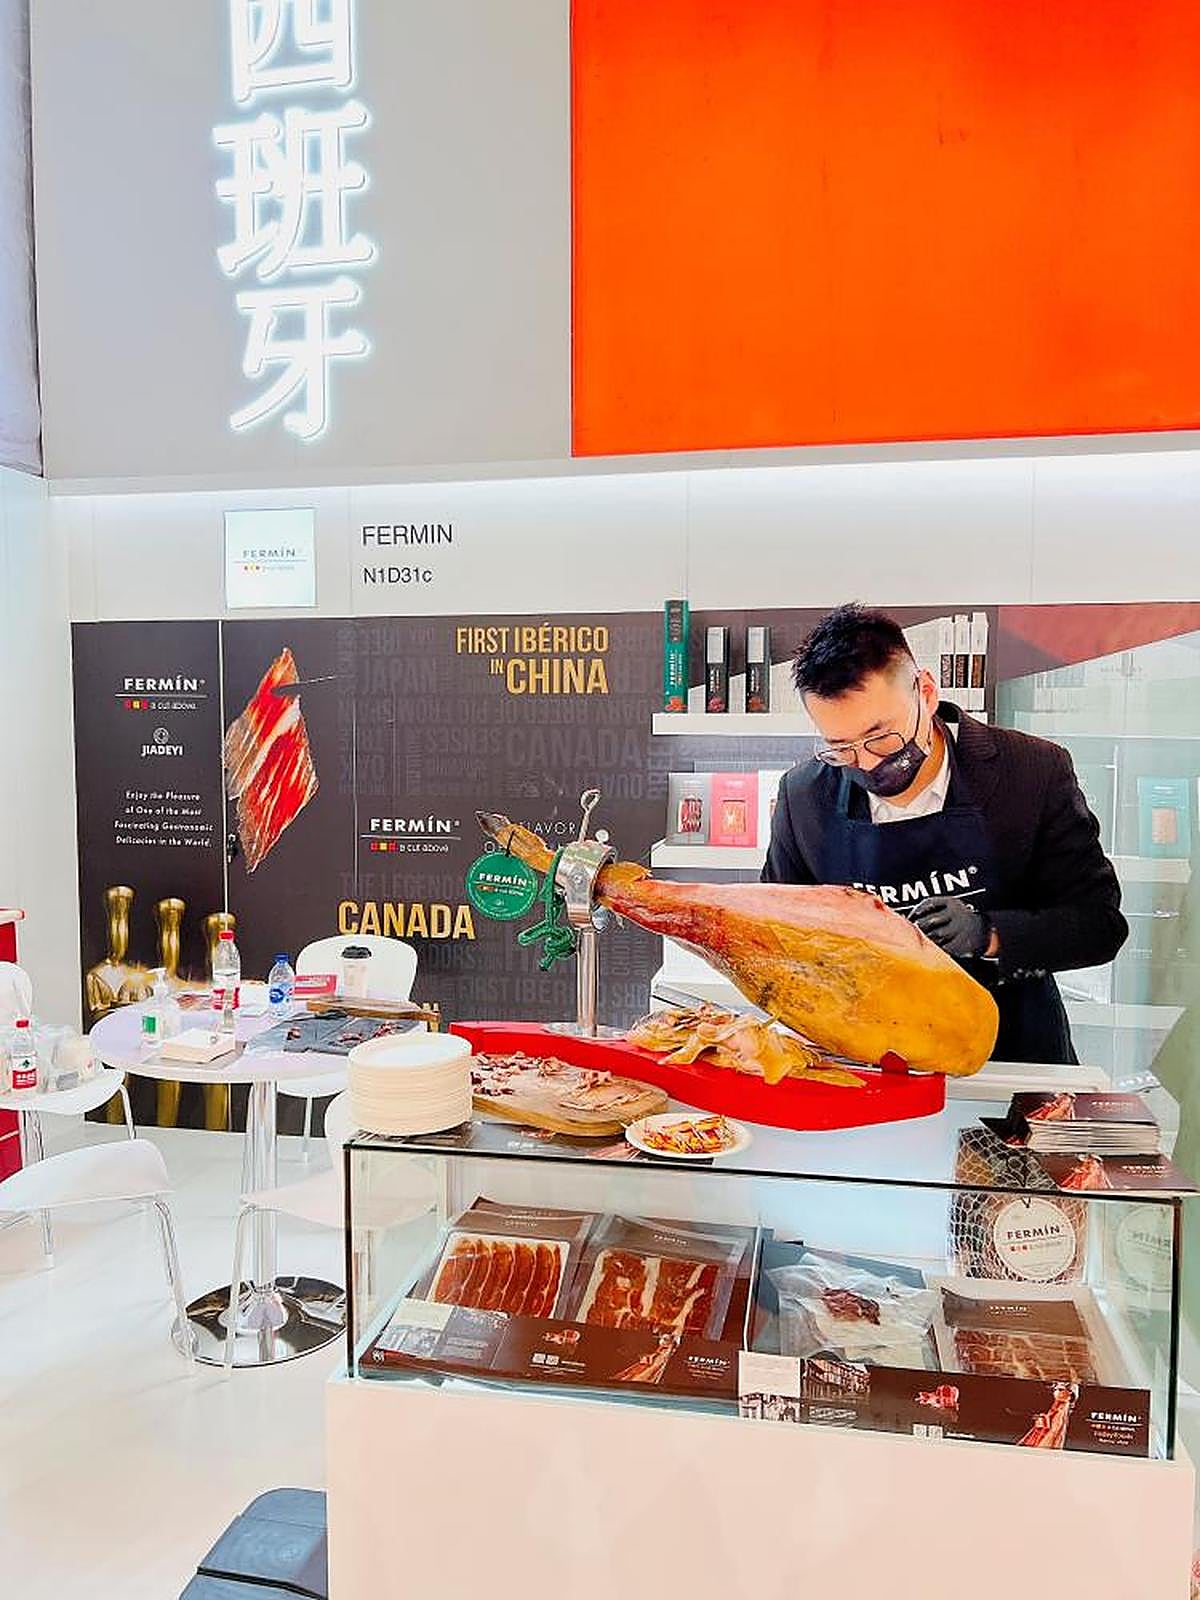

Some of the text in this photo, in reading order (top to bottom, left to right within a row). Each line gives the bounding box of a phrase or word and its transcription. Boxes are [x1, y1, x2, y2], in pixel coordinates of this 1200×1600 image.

[211, 0, 376, 438] 西班牙
[361, 524, 453, 546] FERMIN
[363, 567, 433, 584] N1D31c
[455, 626, 509, 654] FIRST
[514, 622, 609, 653] IBÉRICO
[124, 675, 198, 691] FERMÍN
[490, 658, 504, 675] IN
[506, 658, 609, 694] CHINA
[141, 745, 183, 757] JIADEYI
[370, 815, 451, 833] FERMÍN
[519, 820, 577, 835] LAVOR
[479, 872, 528, 887] FERMÍN
[337, 900, 477, 940] CANADA
